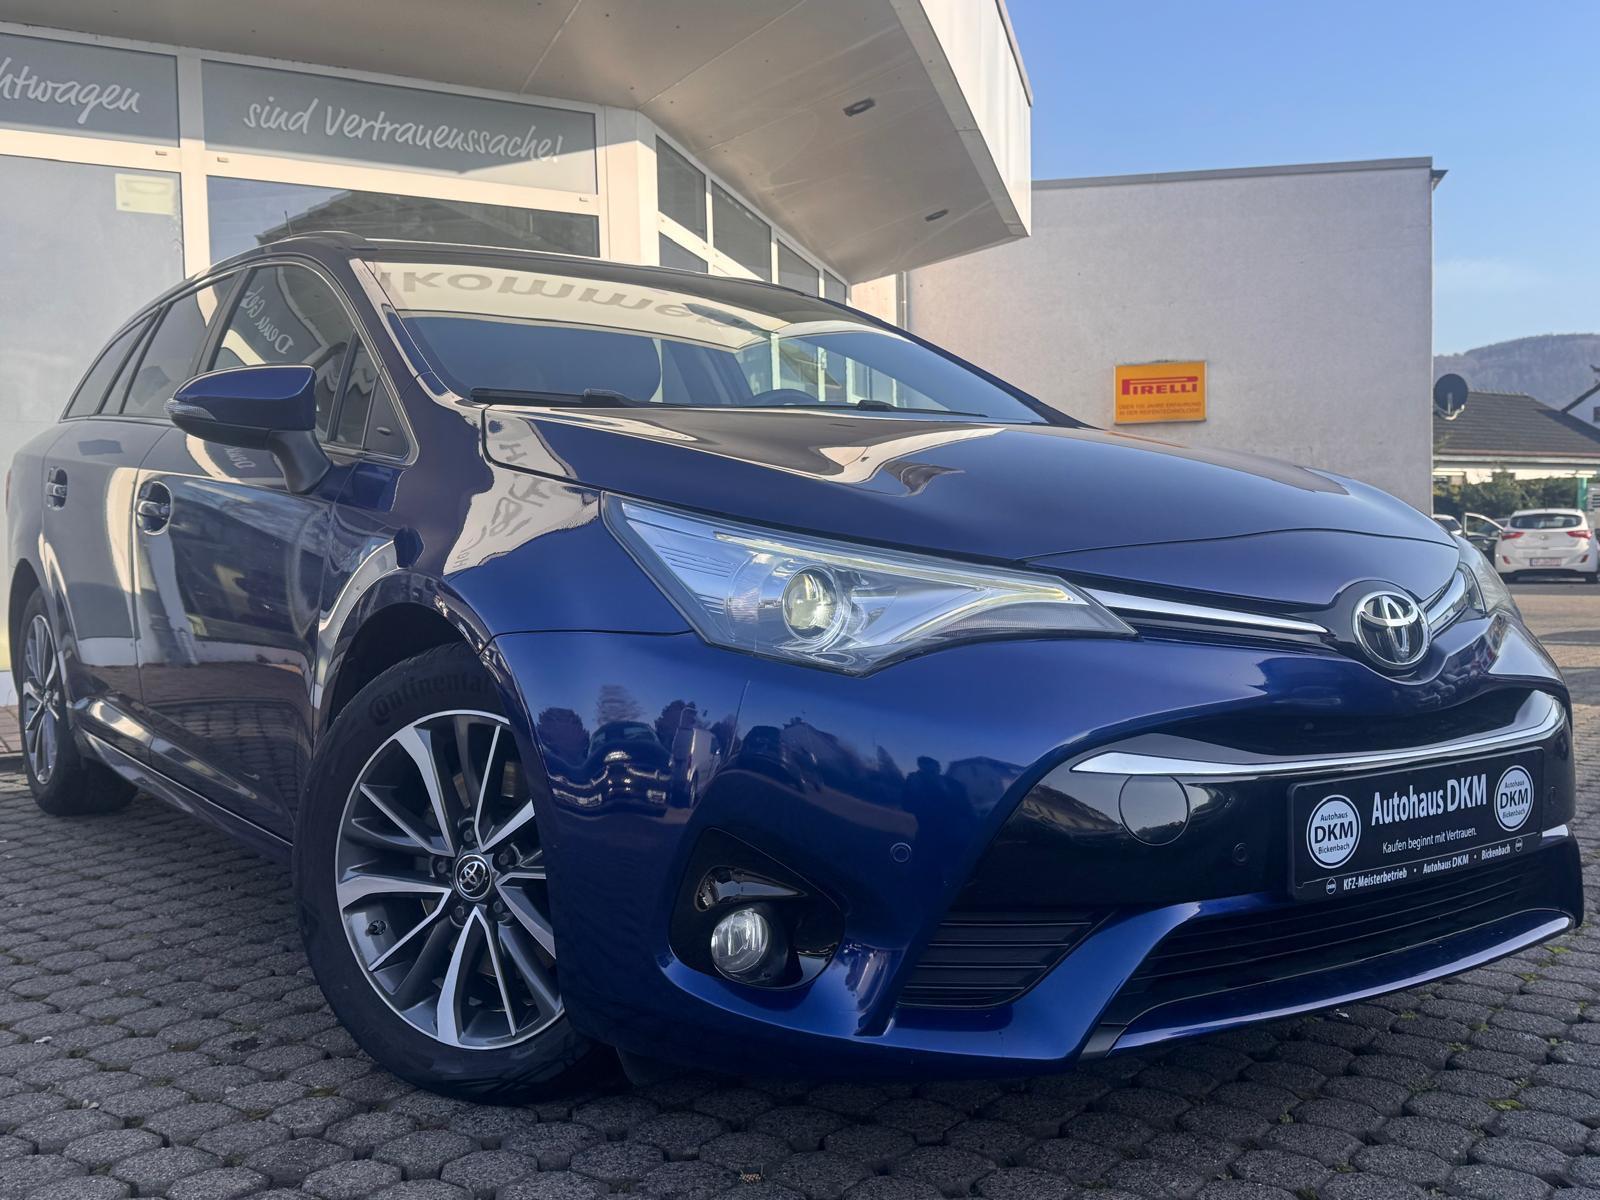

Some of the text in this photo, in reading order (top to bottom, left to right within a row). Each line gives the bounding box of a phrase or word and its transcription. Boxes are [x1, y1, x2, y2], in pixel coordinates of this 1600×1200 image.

[243, 96, 564, 164] sind Vertrauenssache!
[1121, 376, 1199, 395] PIRELLI
[1371, 773, 1487, 826] Autohaus DKM
[1500, 787, 1529, 809] DKM
[1320, 812, 1348, 822] Autohaus
[1314, 821, 1354, 844] DKM
[1382, 840, 1407, 854] Kaufen
[1408, 836, 1434, 851] beginnt
[1434, 831, 1446, 844] mit
[1318, 842, 1350, 854] Bickenbach
[1343, 844, 1510, 890] KFZ-Meisterbetrieb Autohaus DKM Bickenbach
